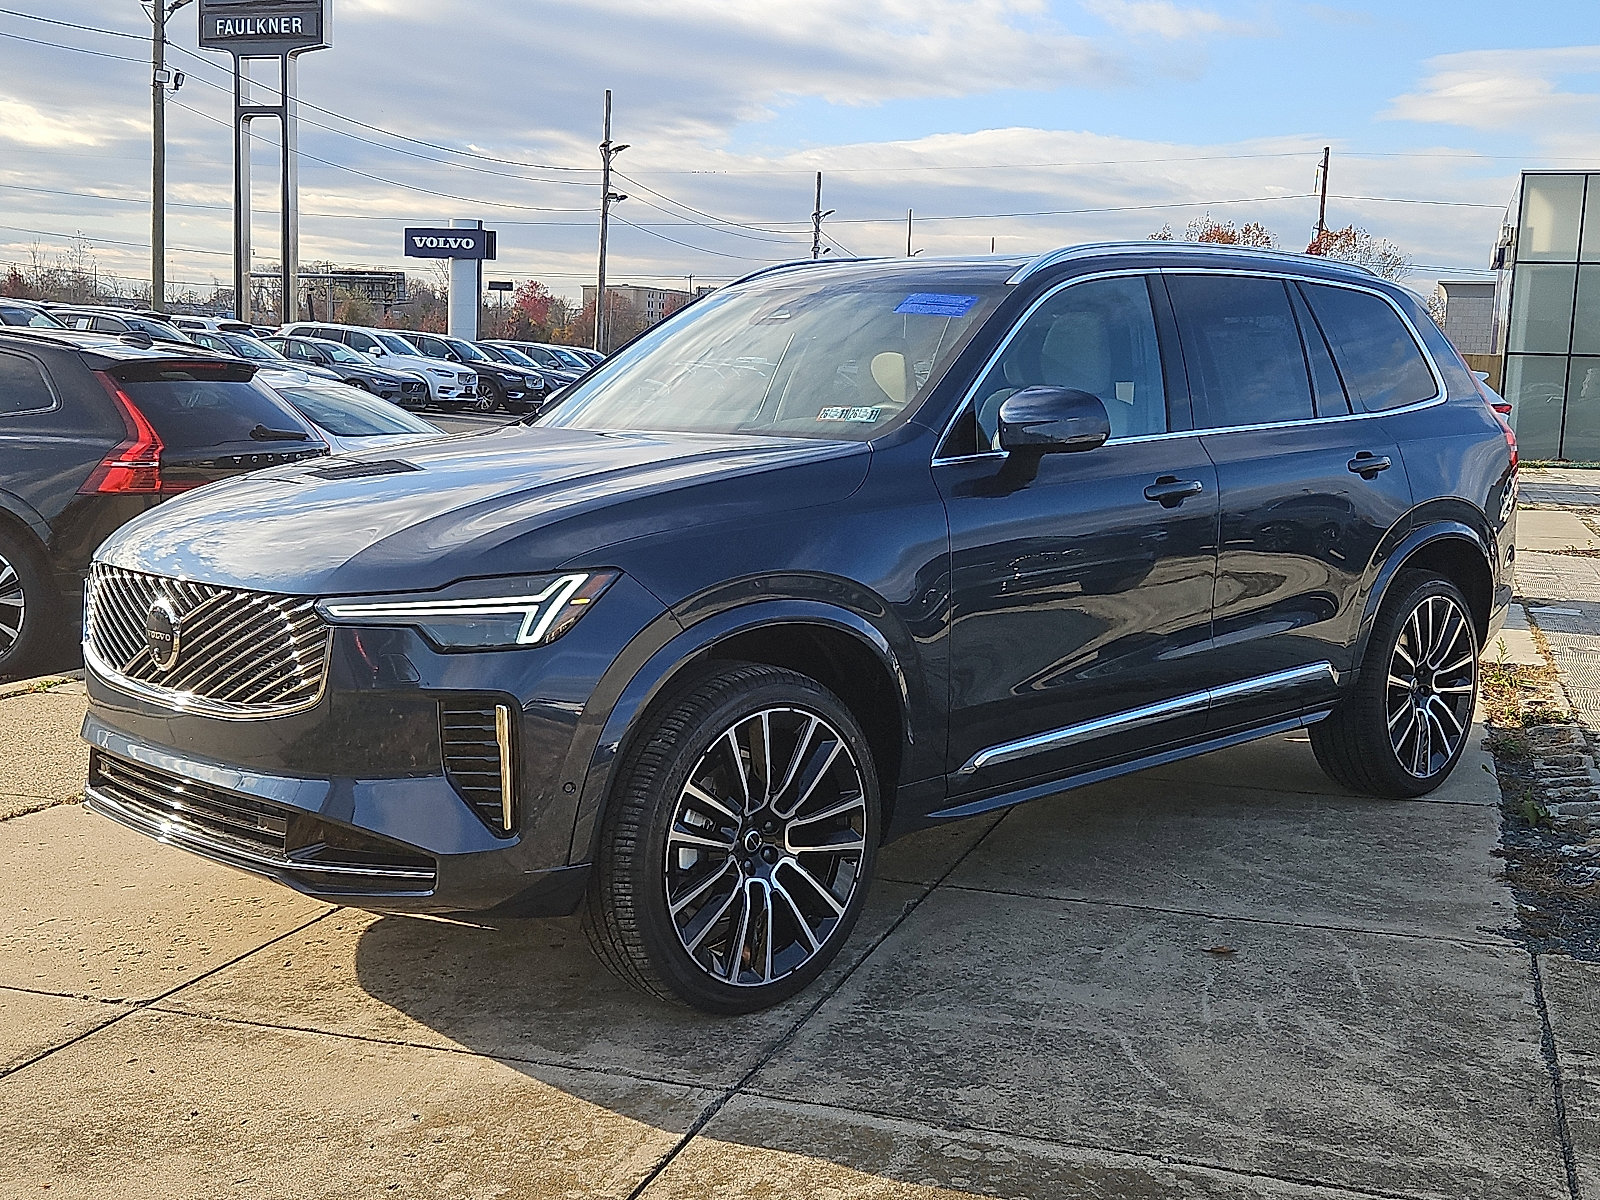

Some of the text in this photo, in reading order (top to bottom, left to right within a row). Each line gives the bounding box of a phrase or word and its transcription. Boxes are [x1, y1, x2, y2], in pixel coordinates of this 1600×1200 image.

[216, 17, 302, 35] FAULKNER
[412, 236, 475, 250] VOLVO
[147, 629, 171, 642] VOLVO
